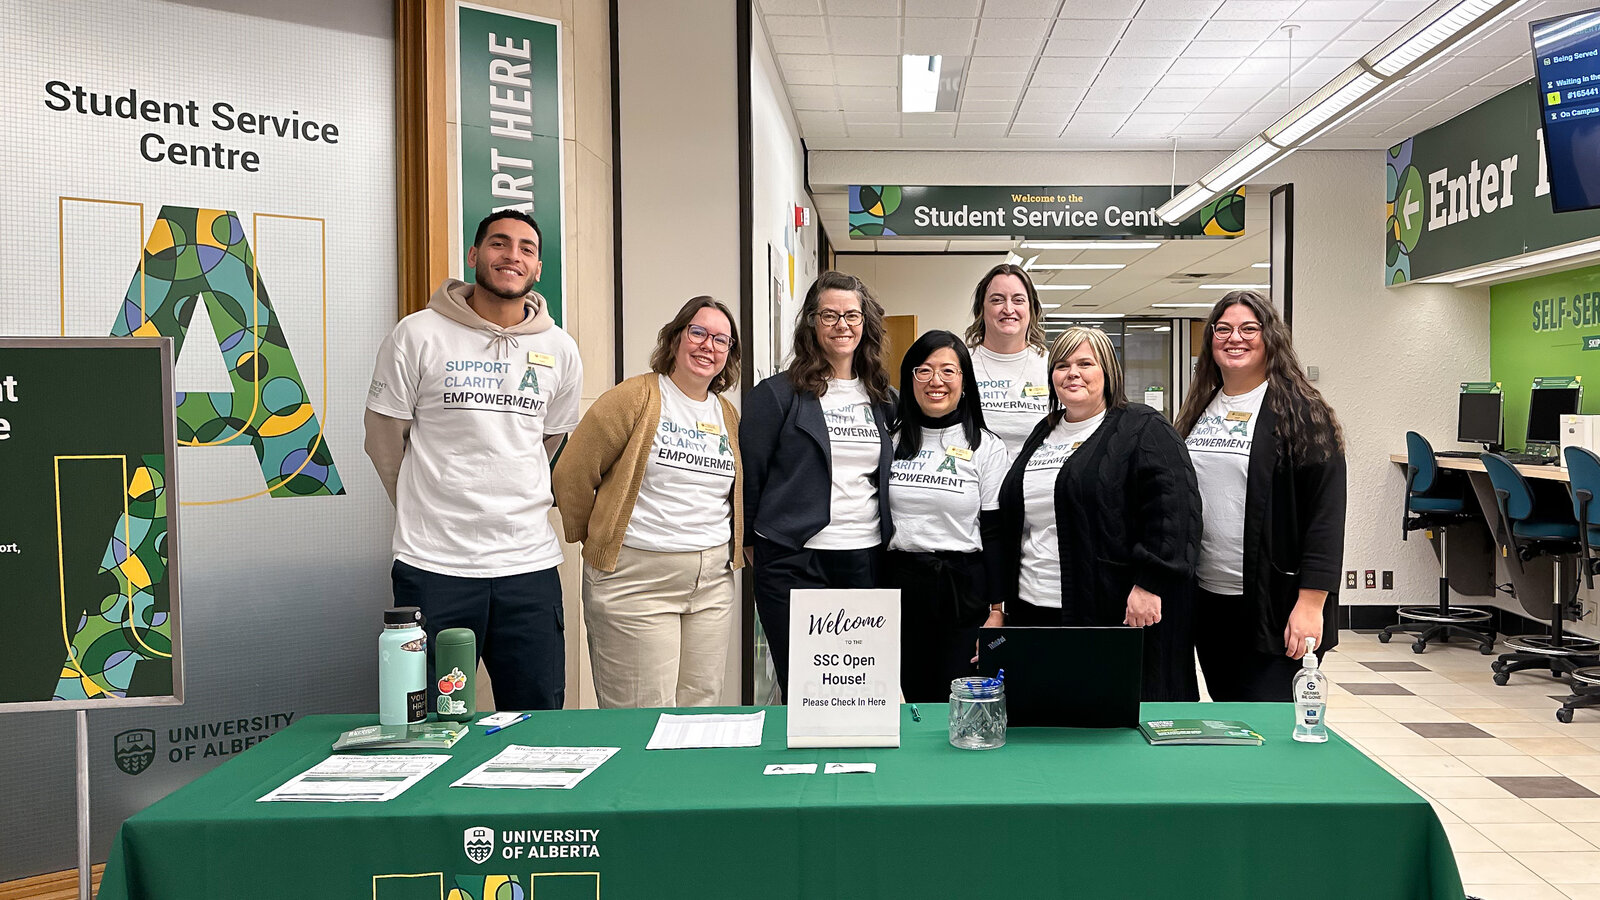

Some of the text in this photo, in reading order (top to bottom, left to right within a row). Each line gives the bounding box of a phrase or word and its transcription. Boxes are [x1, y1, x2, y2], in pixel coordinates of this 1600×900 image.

[1553, 49, 1598, 63] Being Served
[489, 32, 532, 142] HERE
[1556, 77, 1581, 87] Waiting
[45, 80, 339, 144] Student Service
[1560, 106, 1599, 118] On Campus
[140, 133, 260, 172] Centre
[1011, 194, 1084, 203] Welcome to the
[1428, 154, 1518, 231] Enter
[914, 204, 1180, 227] Student Service Cent
[445, 360, 511, 374] SUPPORT
[443, 376, 504, 389] CLARITY
[443, 392, 545, 411] EMPOWERMENT
[980, 401, 1047, 412] POWERMENT
[827, 427, 880, 438] POWERME
[658, 448, 735, 471] EMPOWERMEN
[808, 608, 886, 635] Welcome
[813, 654, 875, 669] SSC Open
[822, 672, 866, 685] House!
[802, 697, 886, 707] Please Check In Here
[169, 712, 294, 743] UNIVERSITY
[169, 746, 196, 762] OF
[502, 829, 600, 843] UNIVERSITY
[502, 845, 600, 859] OF ALBERTA
